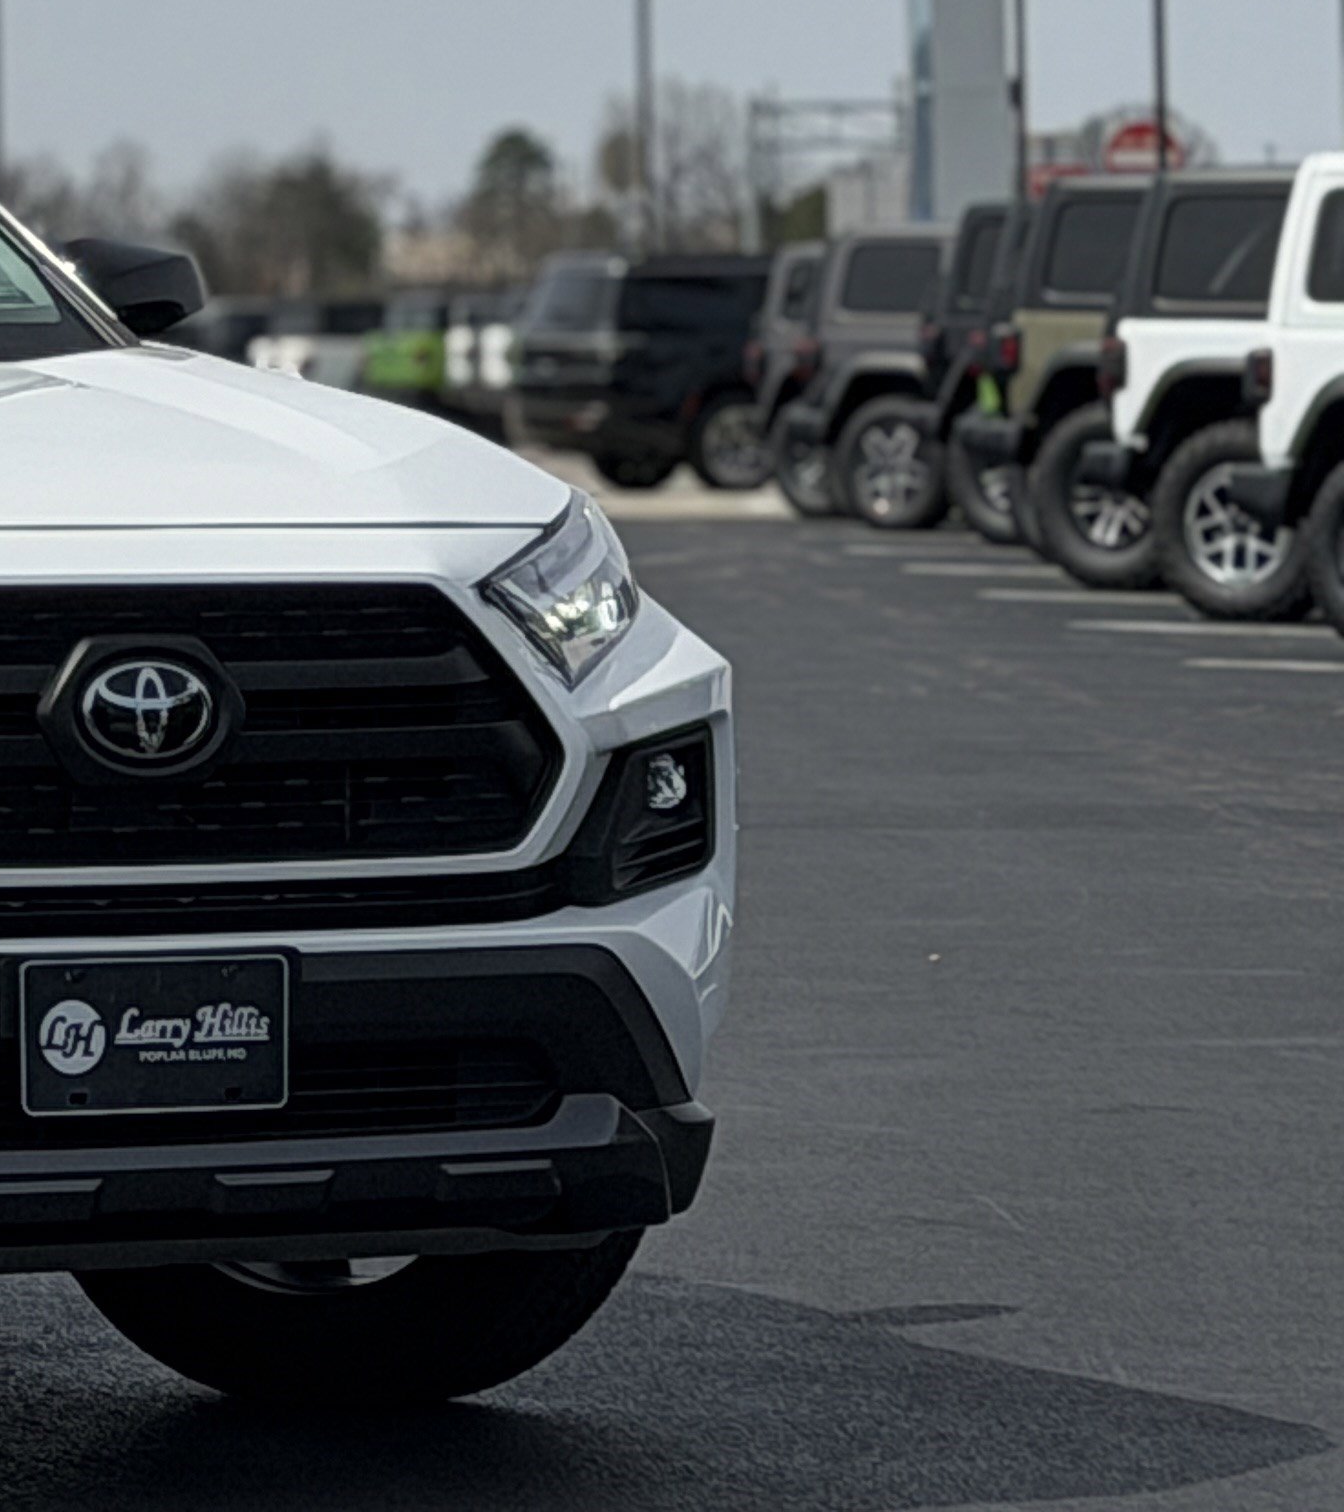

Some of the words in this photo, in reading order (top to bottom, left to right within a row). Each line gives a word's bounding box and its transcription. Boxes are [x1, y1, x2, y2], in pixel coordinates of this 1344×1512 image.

[114, 1006, 192, 1048] Larry
[193, 1002, 270, 1042] Hillis
[138, 1049, 186, 1062] POPLAR
